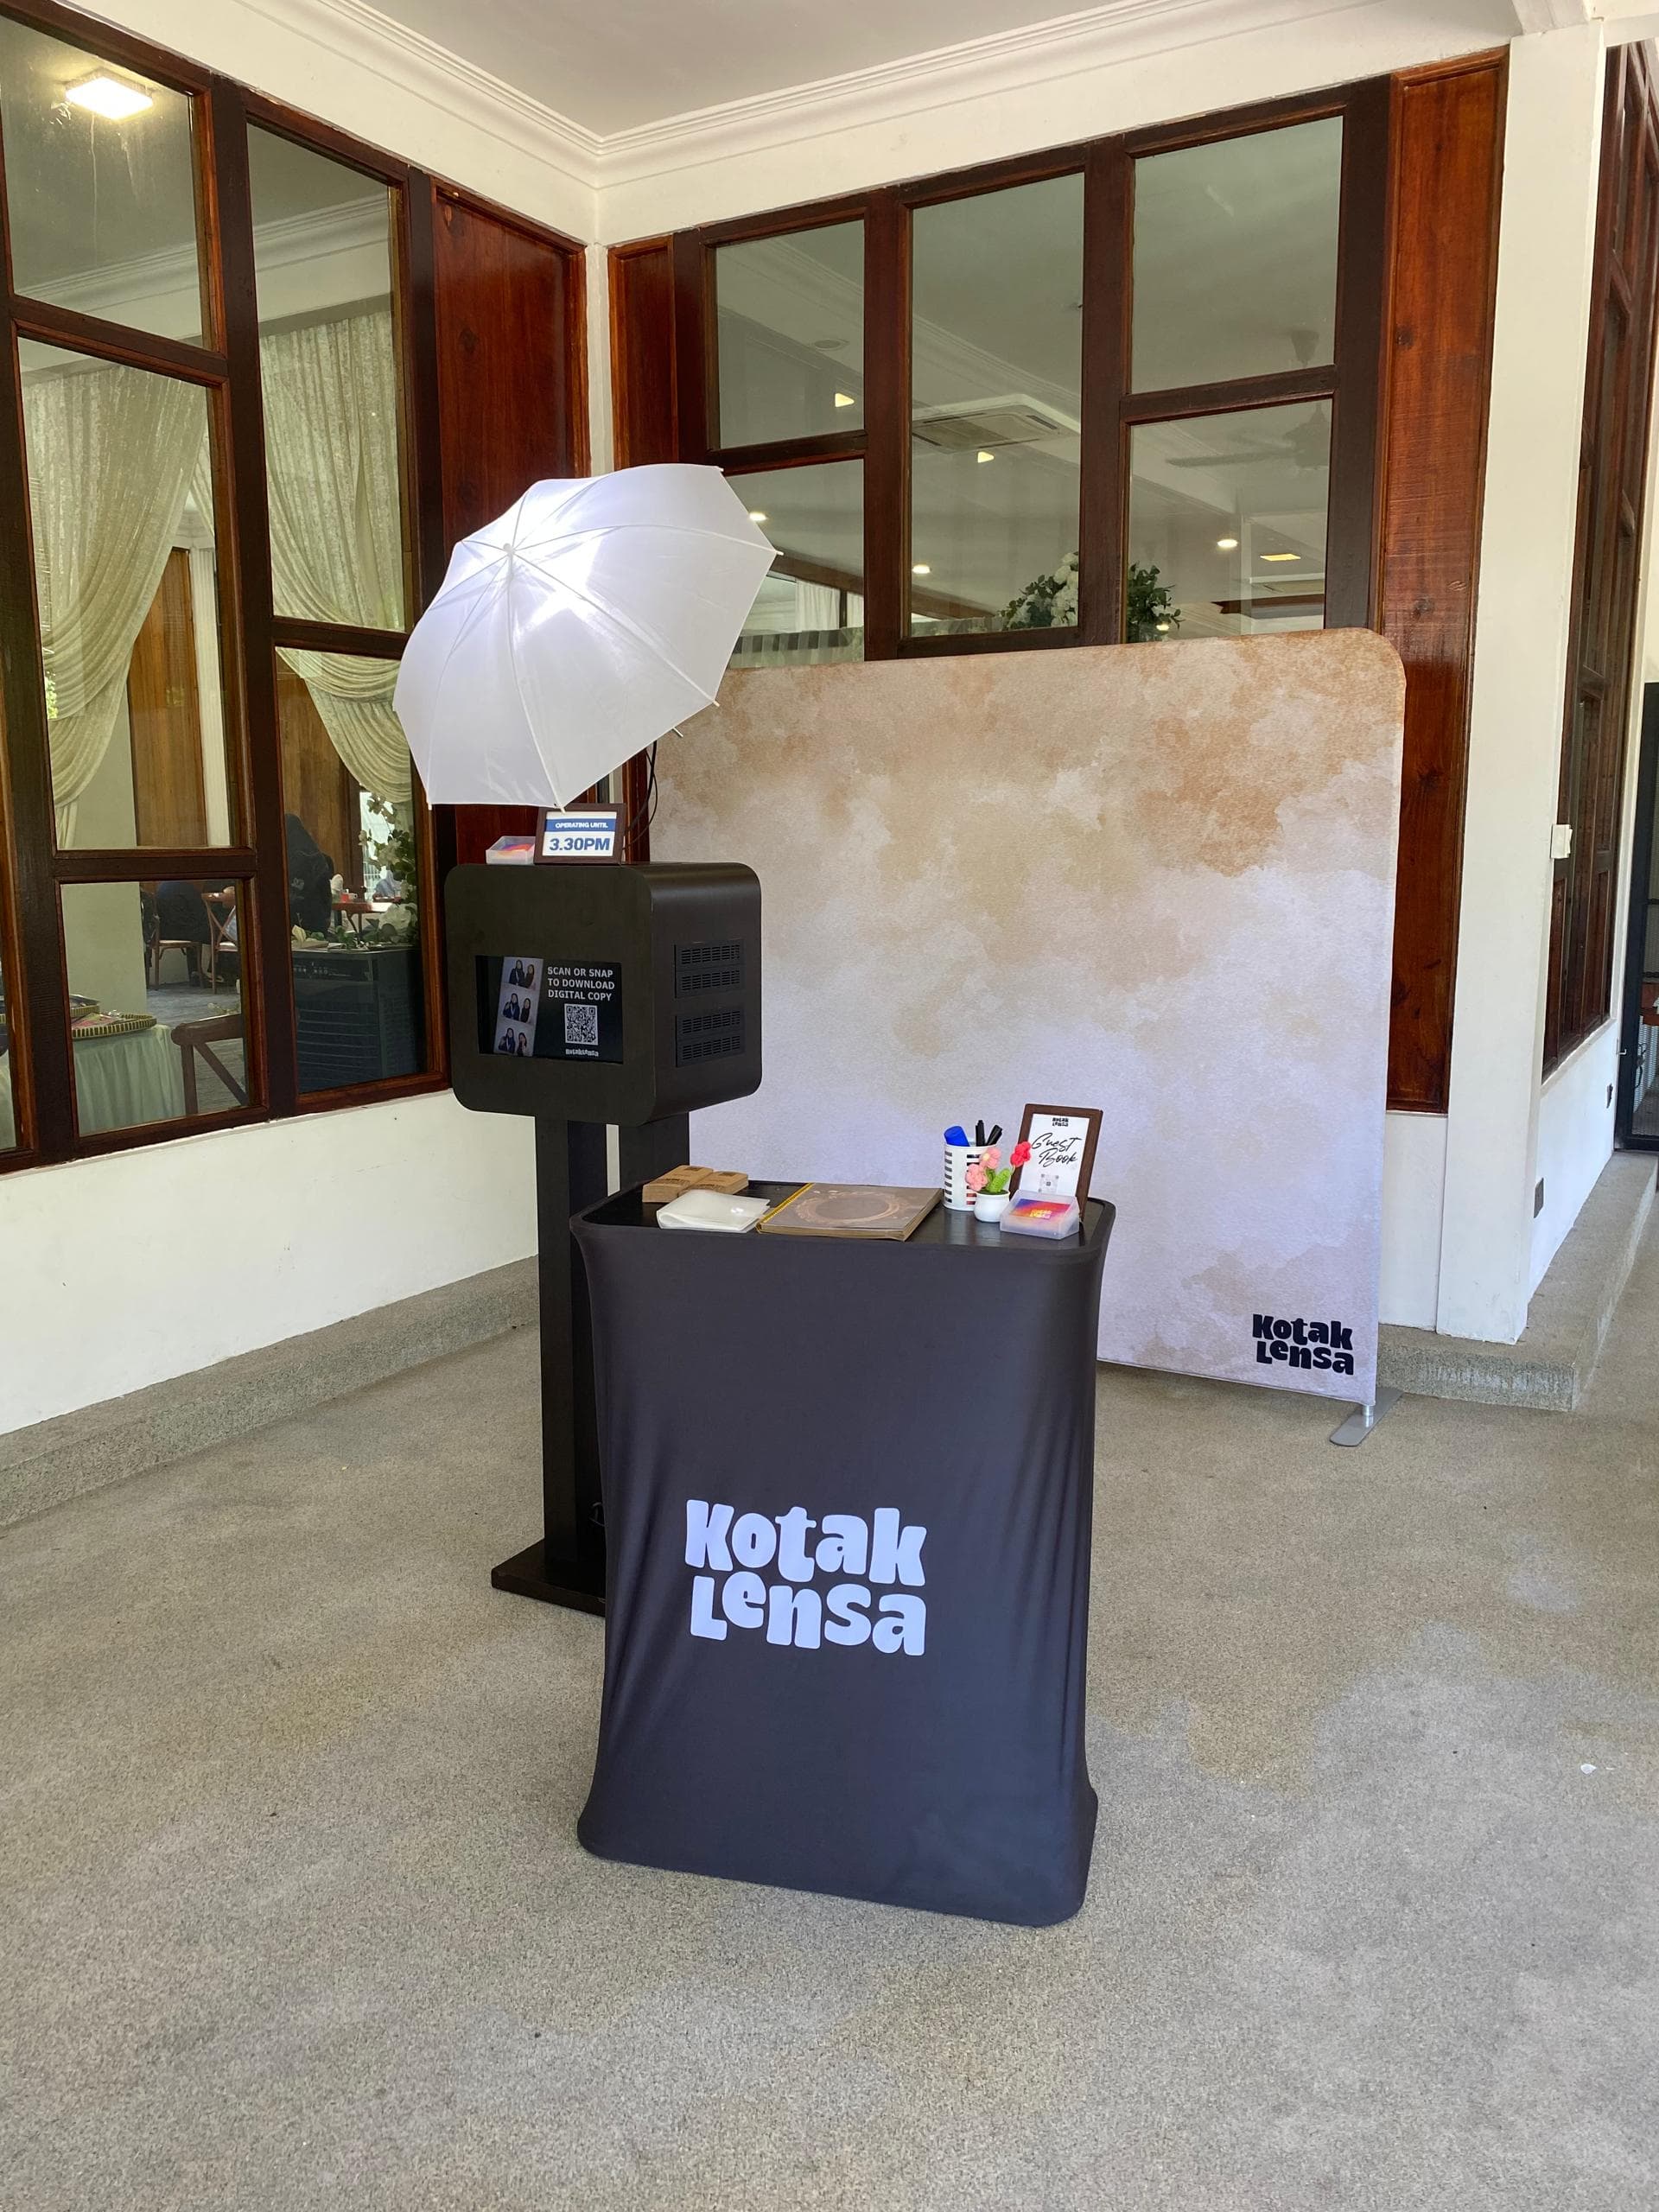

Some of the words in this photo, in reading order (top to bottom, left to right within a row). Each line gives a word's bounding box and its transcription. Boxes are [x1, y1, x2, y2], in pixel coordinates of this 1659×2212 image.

[549, 837, 611, 851] 3.30PM
[547, 966, 571, 976] SCAN
[574, 967, 587, 976] OR
[588, 969, 613, 978] SNAP
[548, 978, 560, 987] TO
[562, 978, 615, 989] DOWNLOAD
[548, 989, 586, 1000] DIGITAL
[588, 991, 612, 1001] COPY
[1039, 1147, 1078, 1167] Book
[1252, 1313, 1353, 1351] Kotak
[1256, 1340, 1354, 1376] Lensa
[685, 1499, 927, 1586] Kotak
[690, 1571, 927, 1656] Lensa
